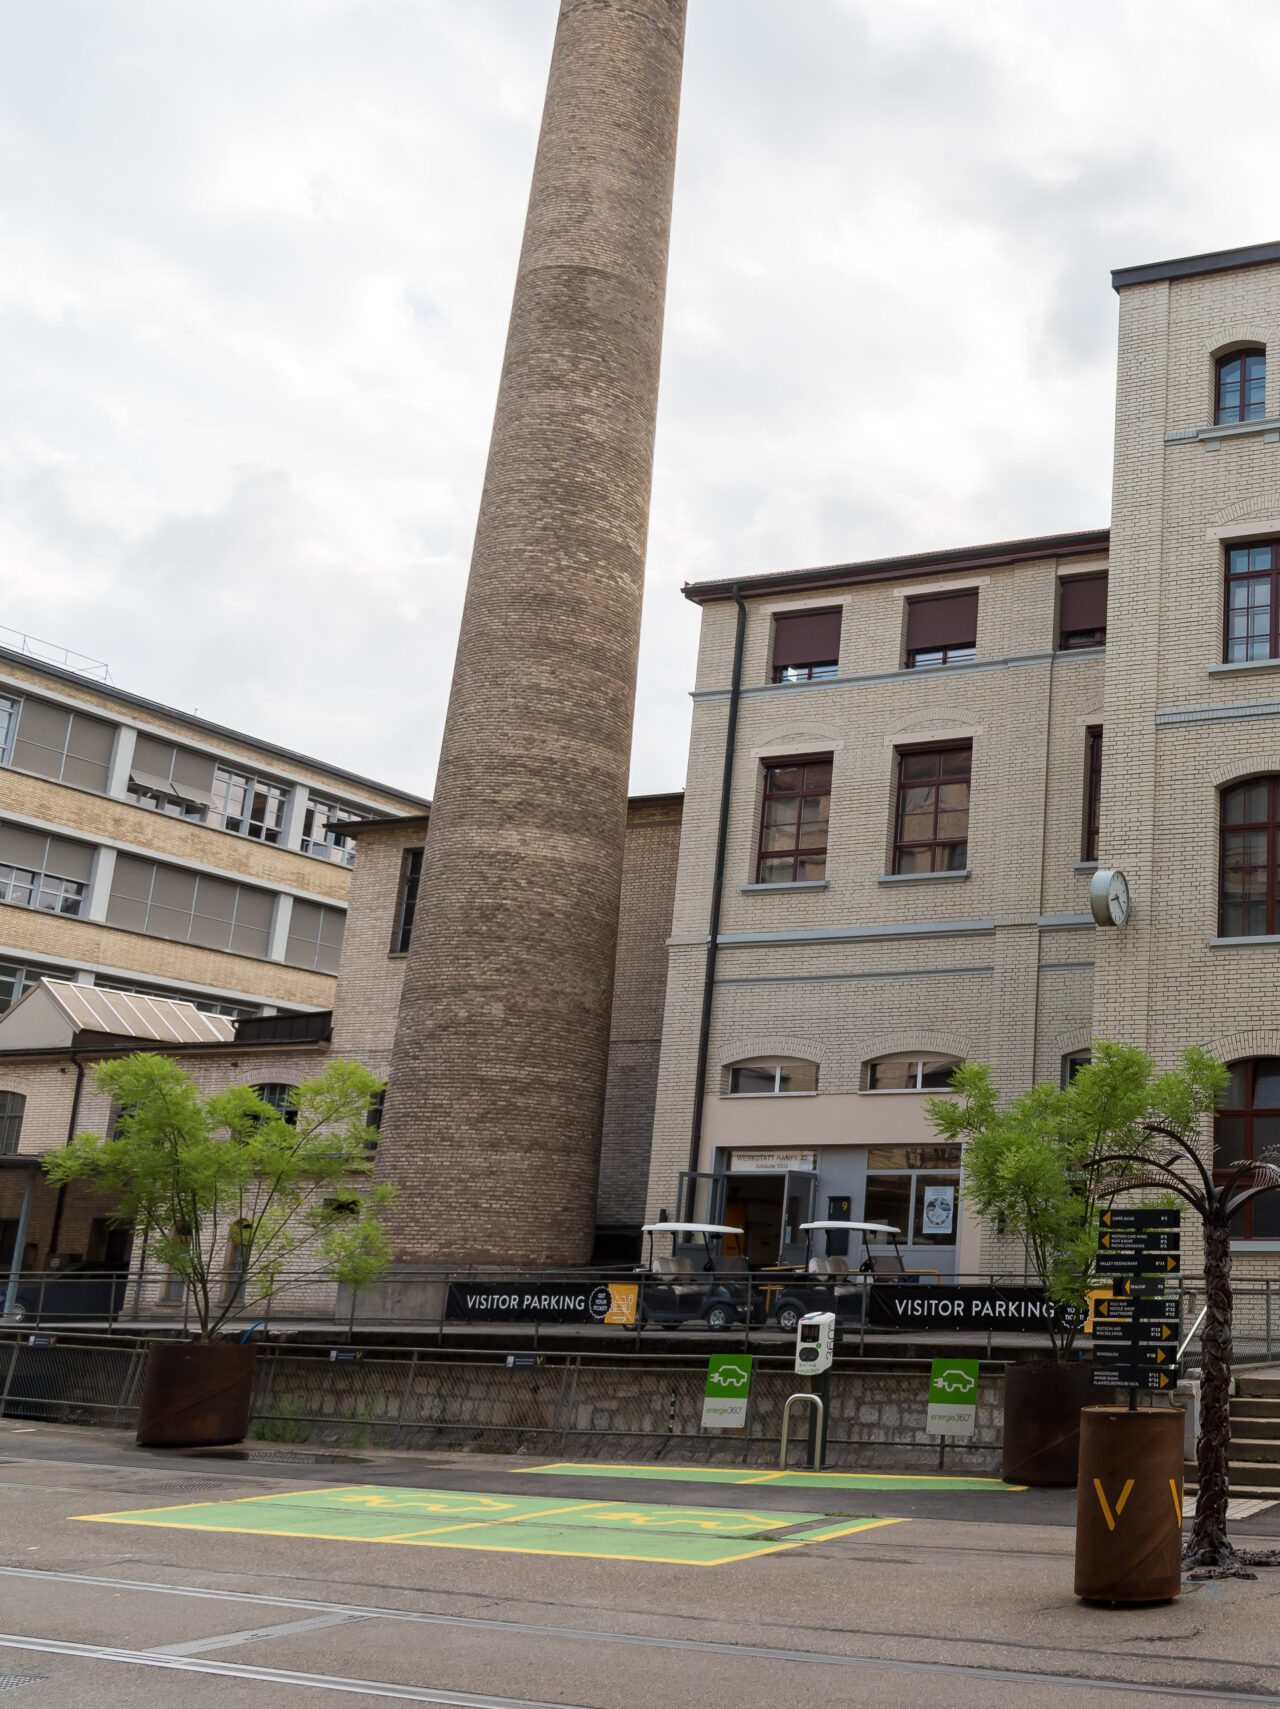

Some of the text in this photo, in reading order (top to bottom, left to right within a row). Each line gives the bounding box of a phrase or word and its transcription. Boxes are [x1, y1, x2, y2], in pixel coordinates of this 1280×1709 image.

[842, 1200, 848, 1211] 9
[467, 1295, 585, 1310] VISITOR PARKING
[895, 1300, 1055, 1318] VISITOR PARKING
